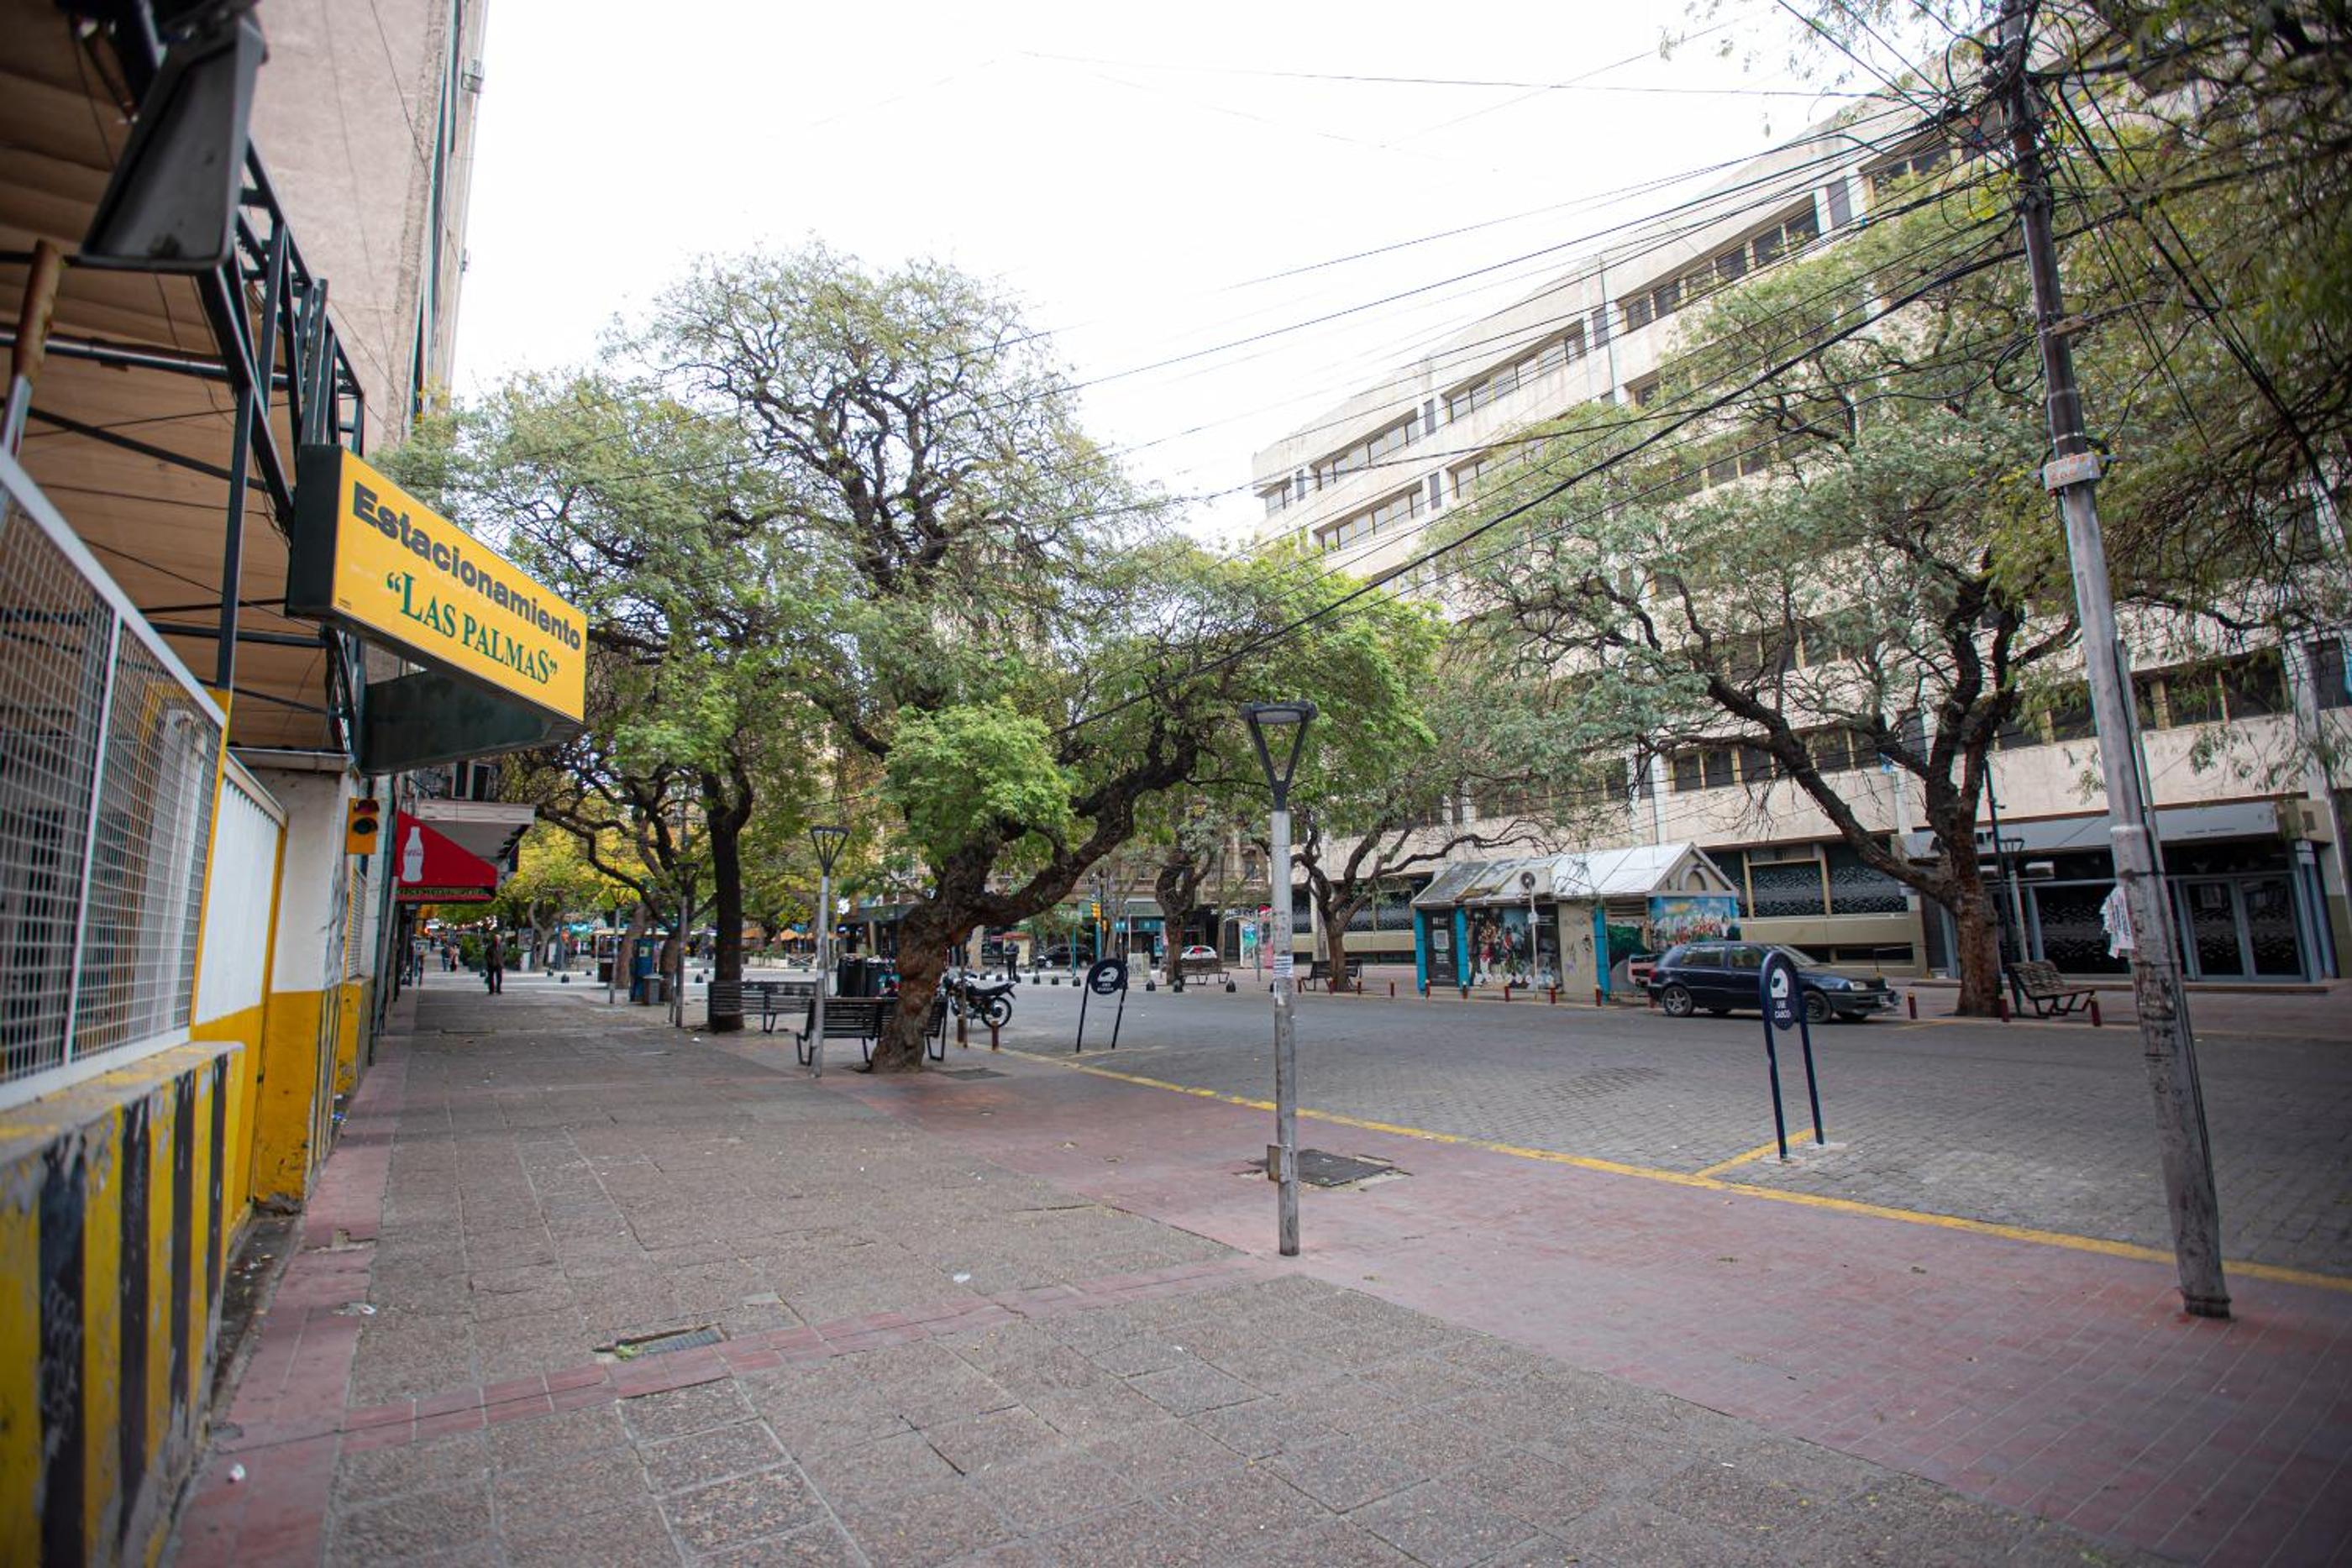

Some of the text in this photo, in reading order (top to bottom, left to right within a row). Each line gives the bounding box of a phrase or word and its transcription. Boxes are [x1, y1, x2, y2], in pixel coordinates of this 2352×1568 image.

[352, 481, 581, 651] Estacionamiento
[386, 571, 558, 684] “LAS PALMAS”
